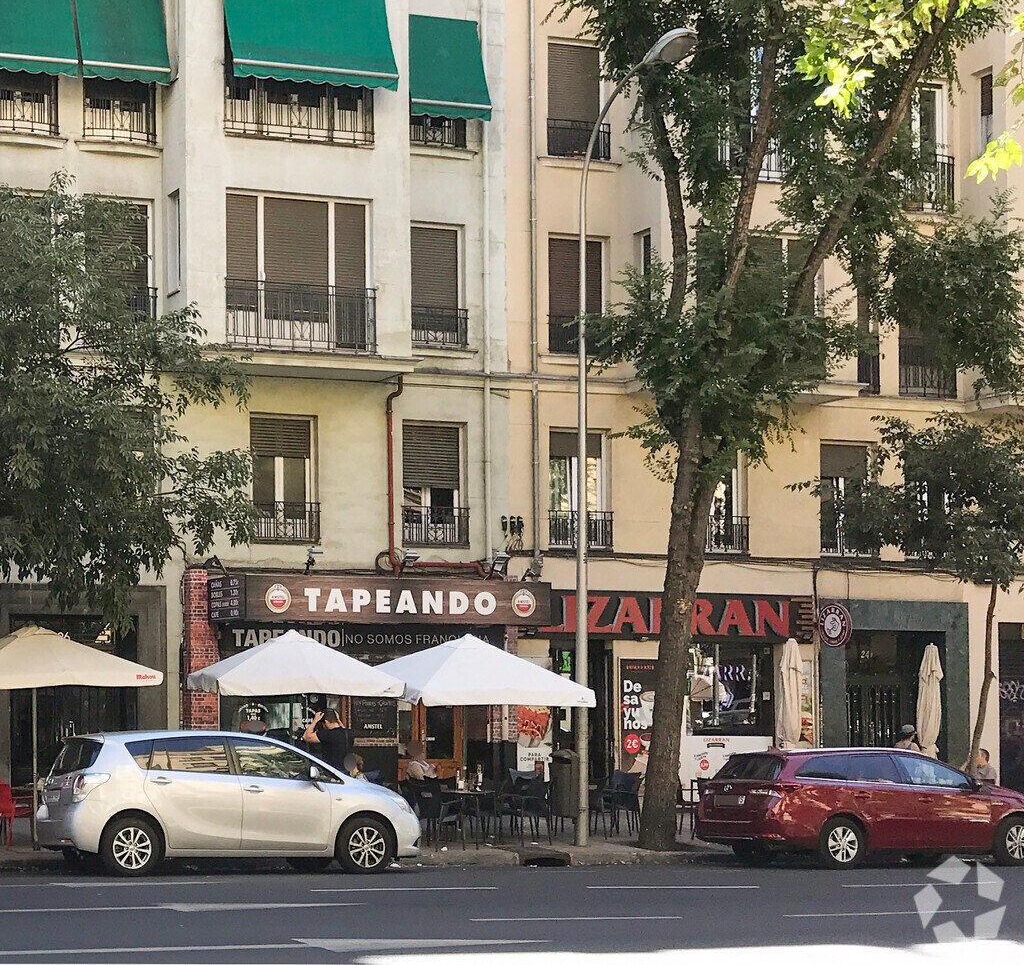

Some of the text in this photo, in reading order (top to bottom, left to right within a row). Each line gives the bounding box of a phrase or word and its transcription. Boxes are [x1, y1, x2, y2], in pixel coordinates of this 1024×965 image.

[304, 588, 497, 616] TAPEANDO
[538, 595, 791, 637] IZARAN
[345, 634, 364, 645] NO
[367, 634, 413, 645] SOMOS
[623, 679, 642, 693] De
[623, 694, 639, 705] sa
[623, 717, 648, 730] nos
[626, 739, 639, 749] 2€
